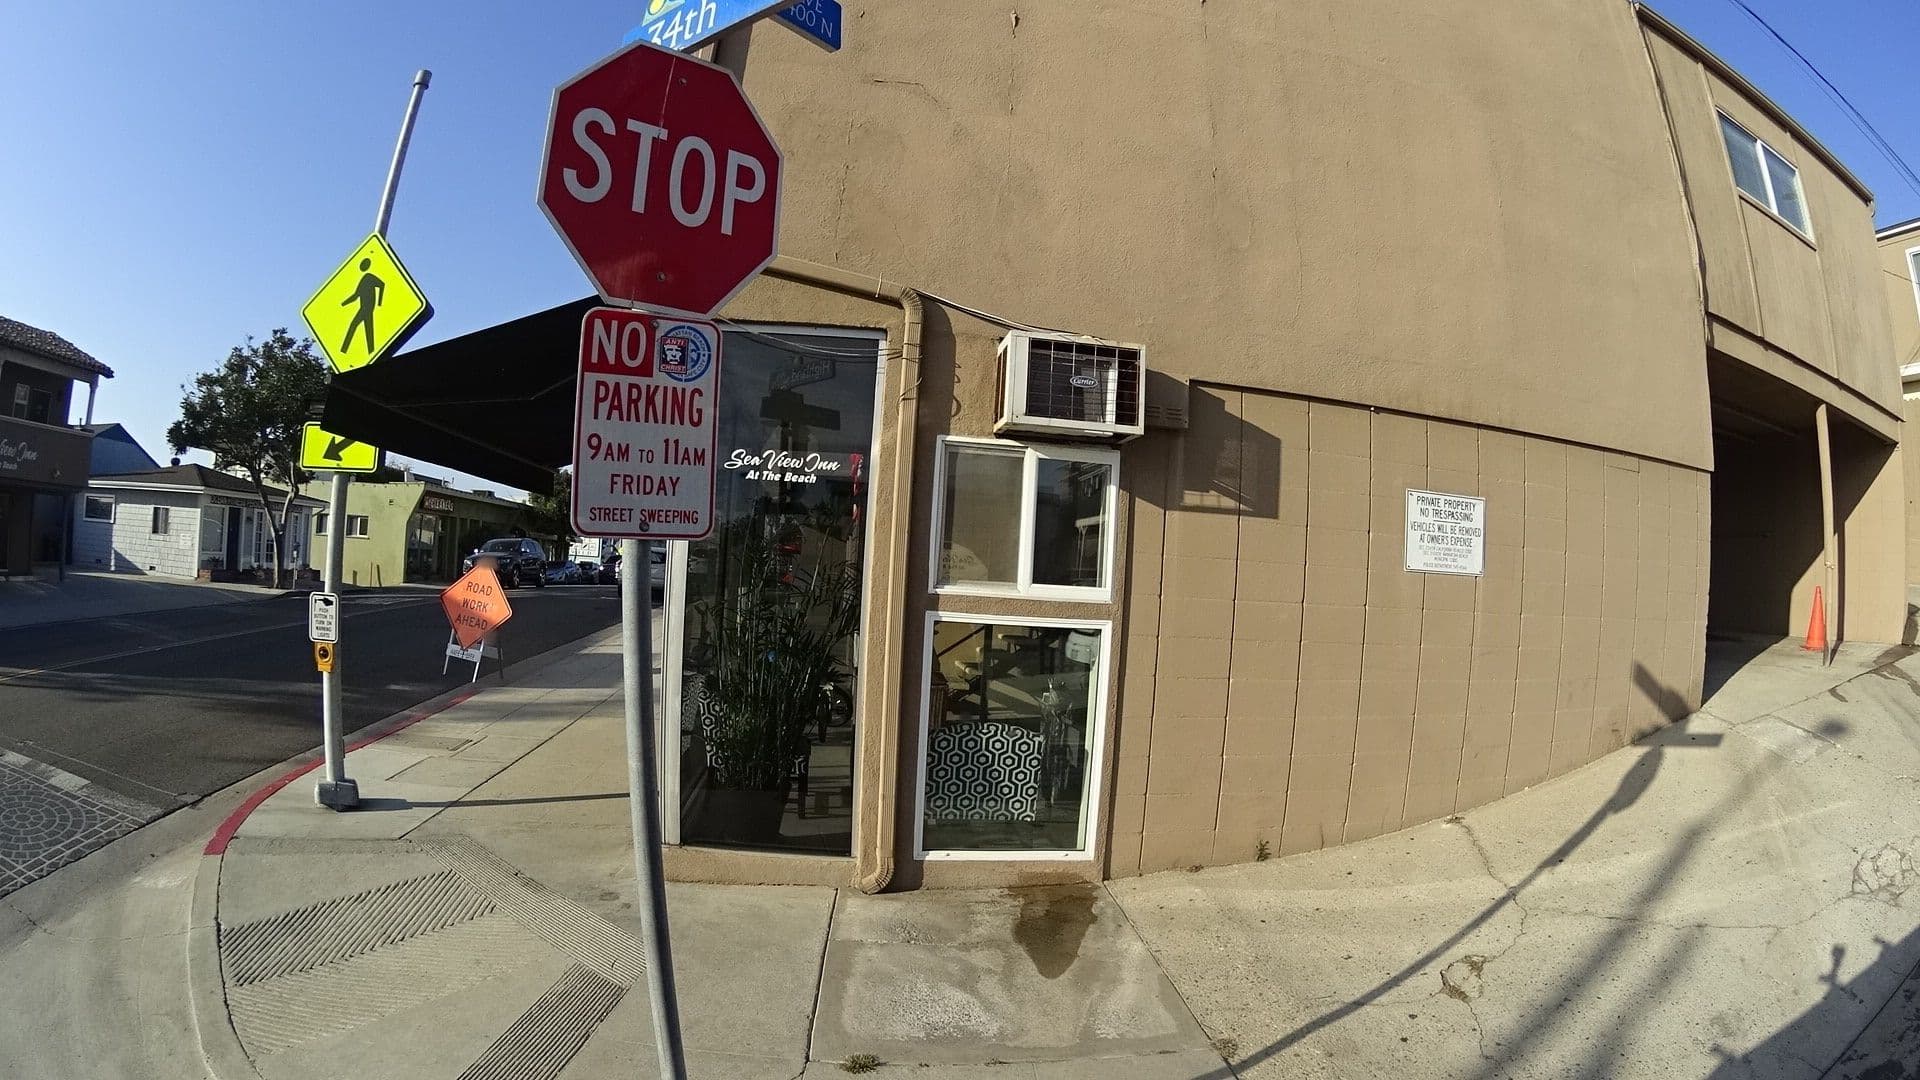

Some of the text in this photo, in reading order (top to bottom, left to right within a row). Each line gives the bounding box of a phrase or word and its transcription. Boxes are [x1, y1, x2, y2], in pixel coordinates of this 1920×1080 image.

[648, 0, 716, 48] 34th
[821, 17, 833, 38] N
[563, 107, 766, 236] STOP
[591, 318, 647, 368] NO
[661, 364, 686, 373] CHRIST
[593, 380, 703, 427] PARKING
[587, 433, 706, 467] 9AM TO 11AM
[724, 449, 840, 473] Sea View Inn
[610, 474, 680, 497] FRIDAY
[746, 470, 817, 484] At The Beach
[1416, 496, 1477, 512] PRIVATE PROPERTY
[589, 507, 699, 524] STREET SWEEPING
[1420, 508, 1474, 522] NO TRESPASSING
[1410, 521, 1481, 538] VEHICLES WILL BE REMOVED
[1419, 534, 1426, 543] AT
[1450, 537, 1473, 548] EXPENSE
[466, 581, 493, 596] ROAD
[462, 597, 488, 613] WORK
[455, 614, 488, 630] AHEAD
